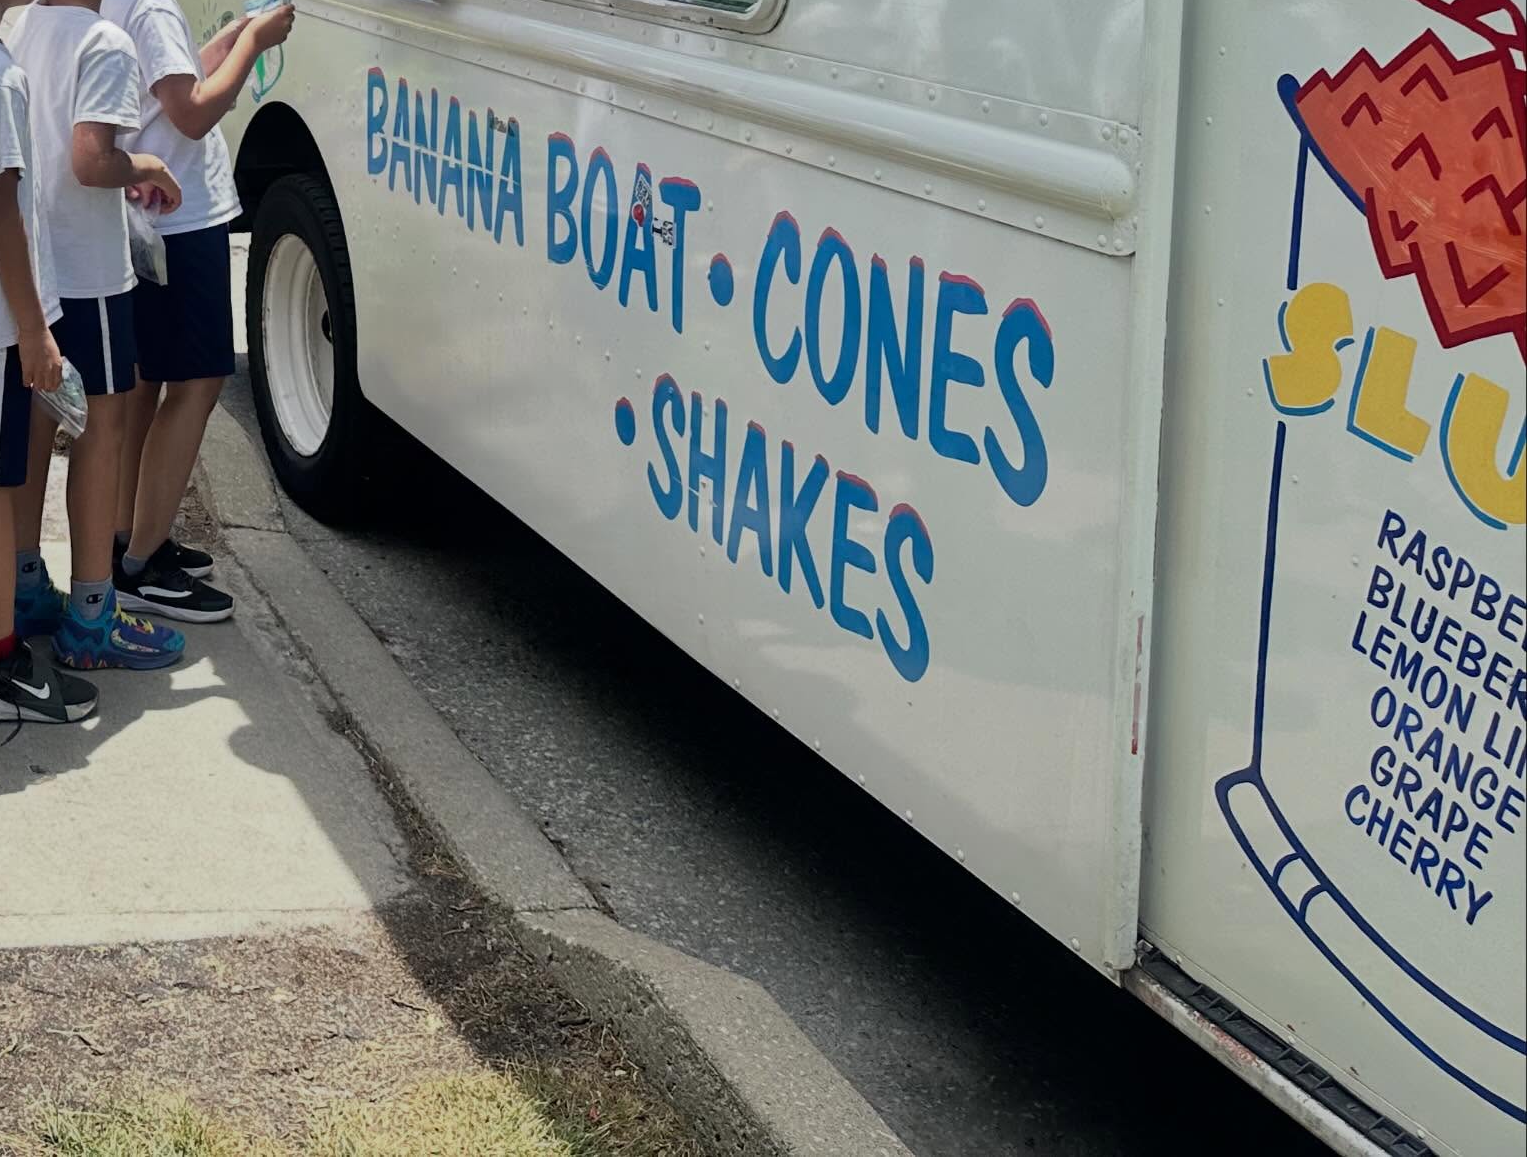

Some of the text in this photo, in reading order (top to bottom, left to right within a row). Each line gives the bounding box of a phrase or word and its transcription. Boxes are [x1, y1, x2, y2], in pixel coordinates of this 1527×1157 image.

[366, 65, 1054, 507] BANANA BOAT CONES
[646, 372, 934, 683] SHAKES
[1376, 508, 1526, 652] RASPBE
[1351, 610, 1526, 779] LEMON LI
[1371, 685, 1526, 835] ORANGE
[1344, 783, 1494, 926] CHERRY
[1370, 743, 1494, 871] GRAPE
